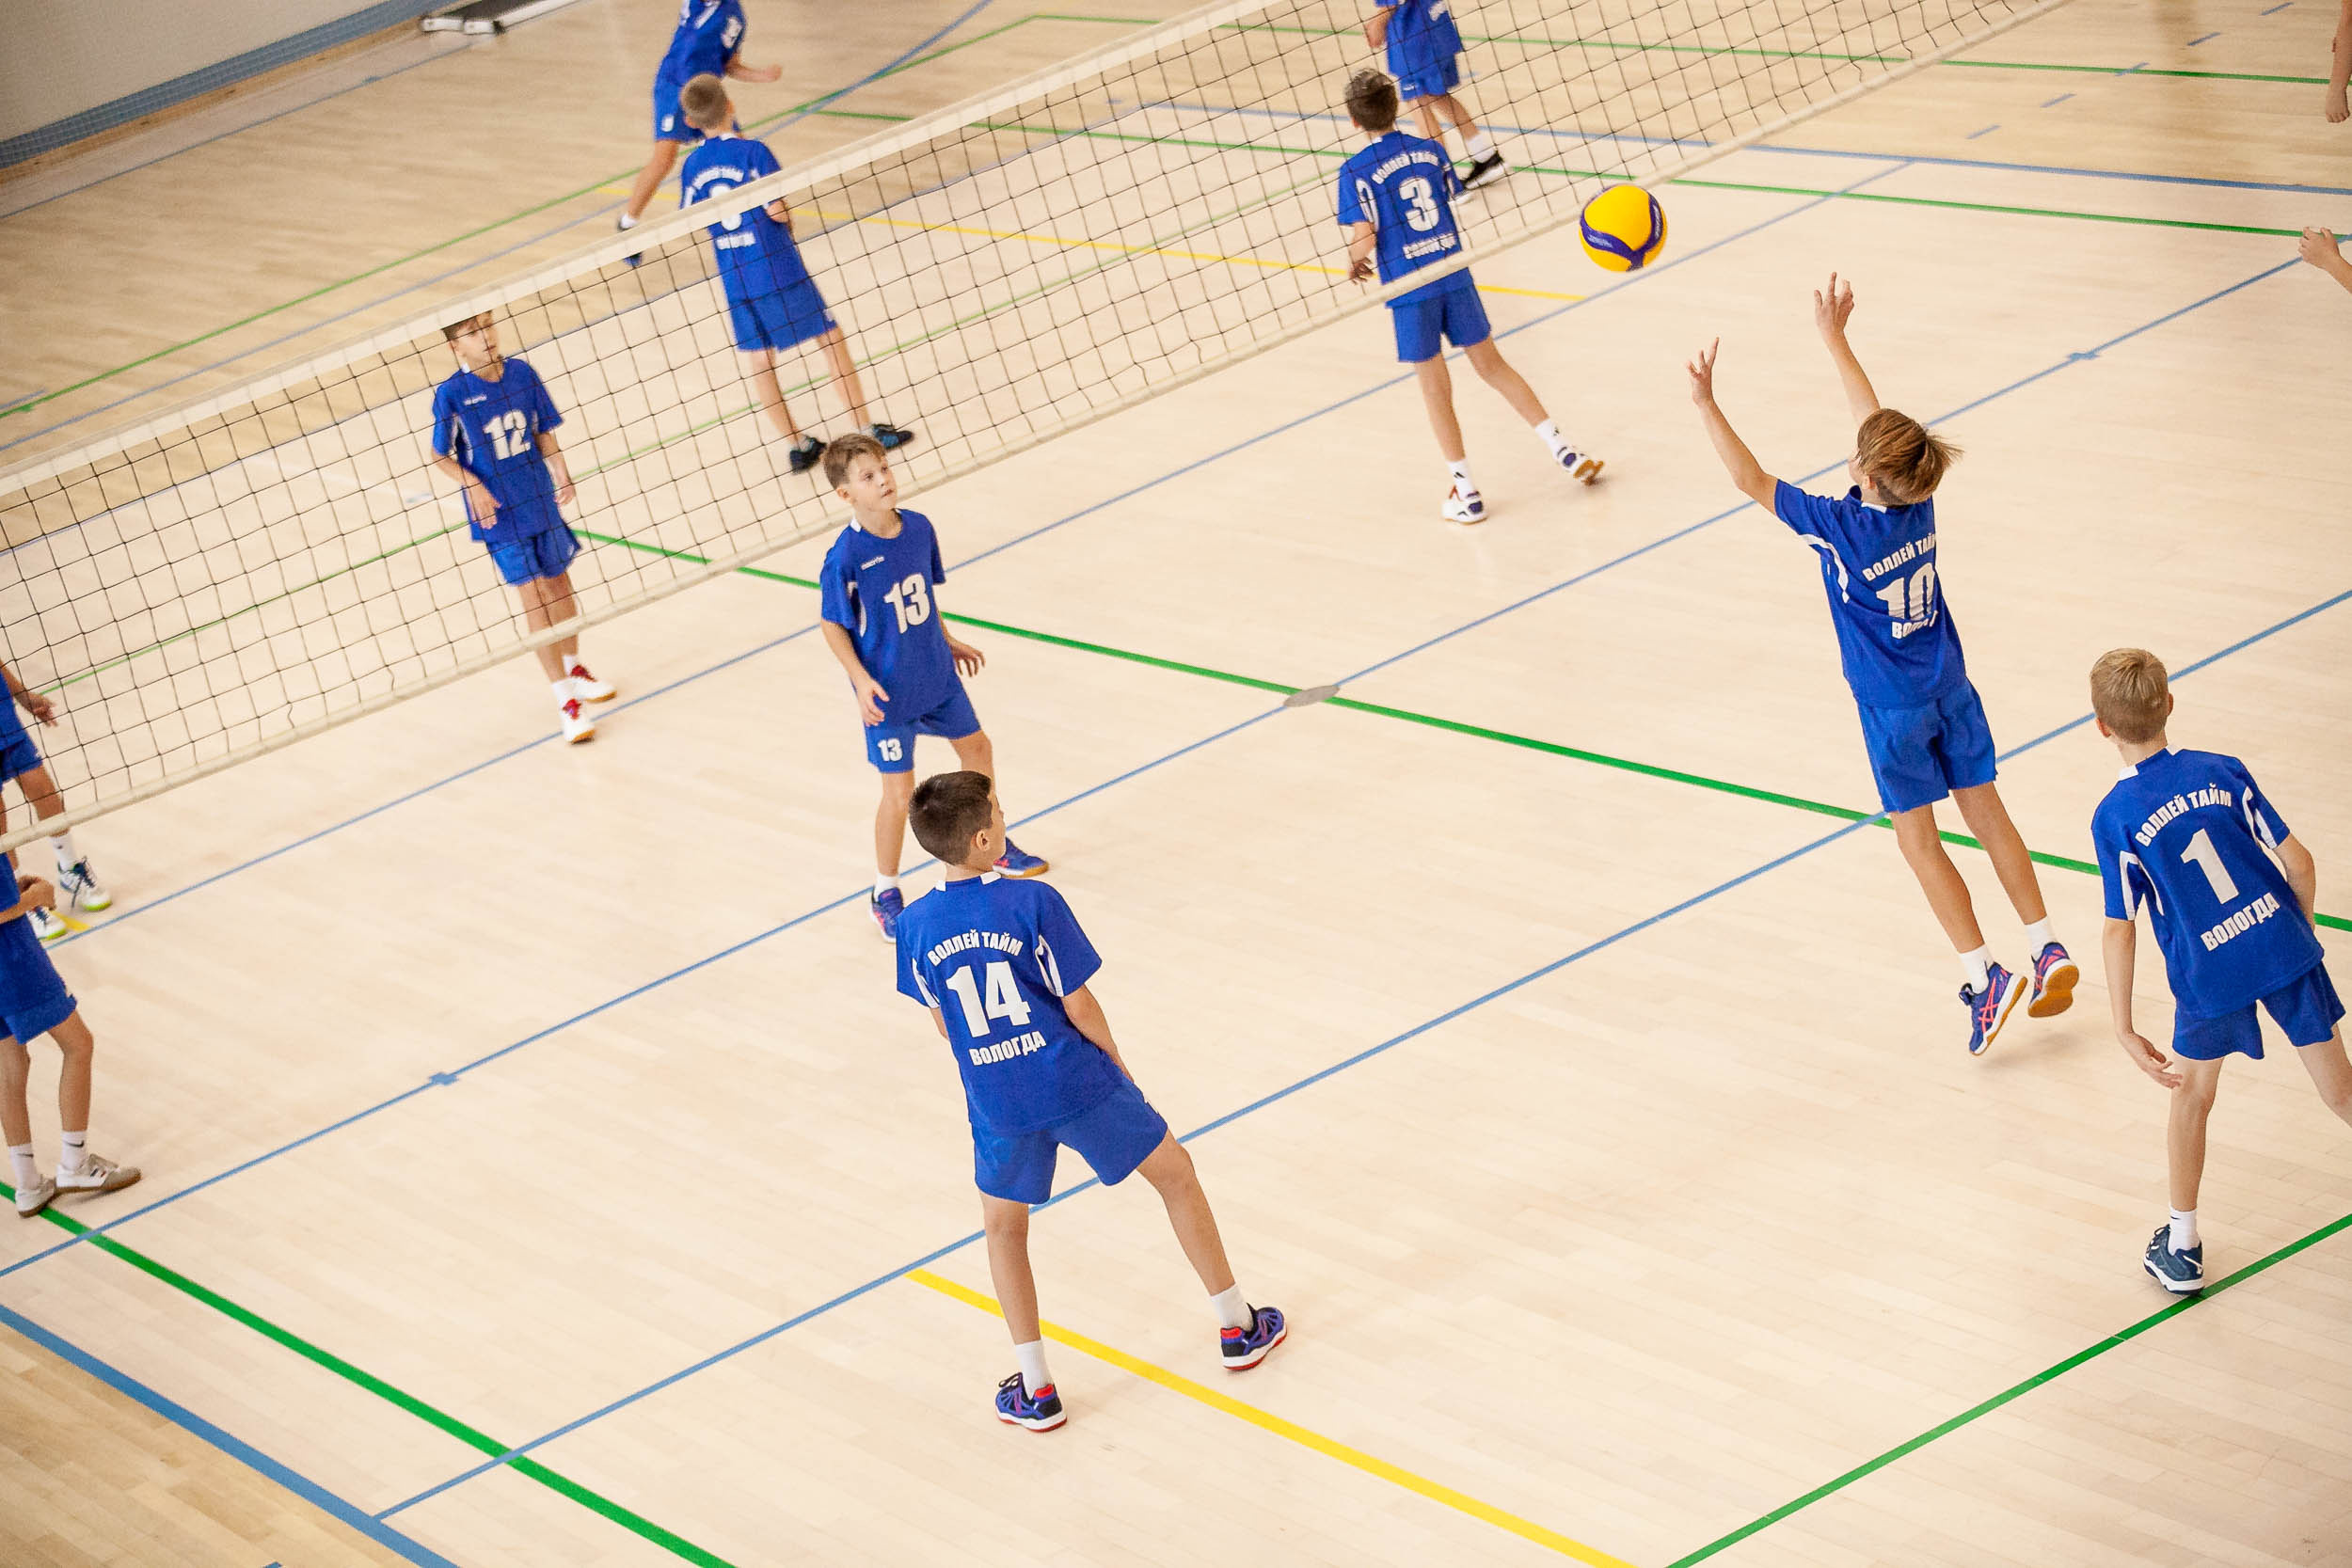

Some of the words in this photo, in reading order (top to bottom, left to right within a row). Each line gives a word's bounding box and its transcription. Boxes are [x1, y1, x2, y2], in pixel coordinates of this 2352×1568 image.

[1399, 177, 1439, 231] 3
[483, 409, 531, 460] 12
[1862, 542, 1915, 581] ВОЛЛЕЙ
[1915, 532, 1936, 555] ТАЙ
[883, 573, 930, 634] 13
[1876, 562, 1935, 621] 10
[877, 738, 903, 762] 13
[2135, 793, 2189, 847] ВОЛЛЕЙ
[2187, 783, 2232, 807] ТАЙМ
[2180, 828, 2239, 905] 1
[927, 928, 981, 967] ВОЛЛЕЙ
[981, 932, 1024, 957] ТАЙМ
[2200, 892, 2280, 952] ВОЛОГДА
[946, 960, 1031, 1037] 14
[968, 1030, 1047, 1067] ВОЛОГДА
